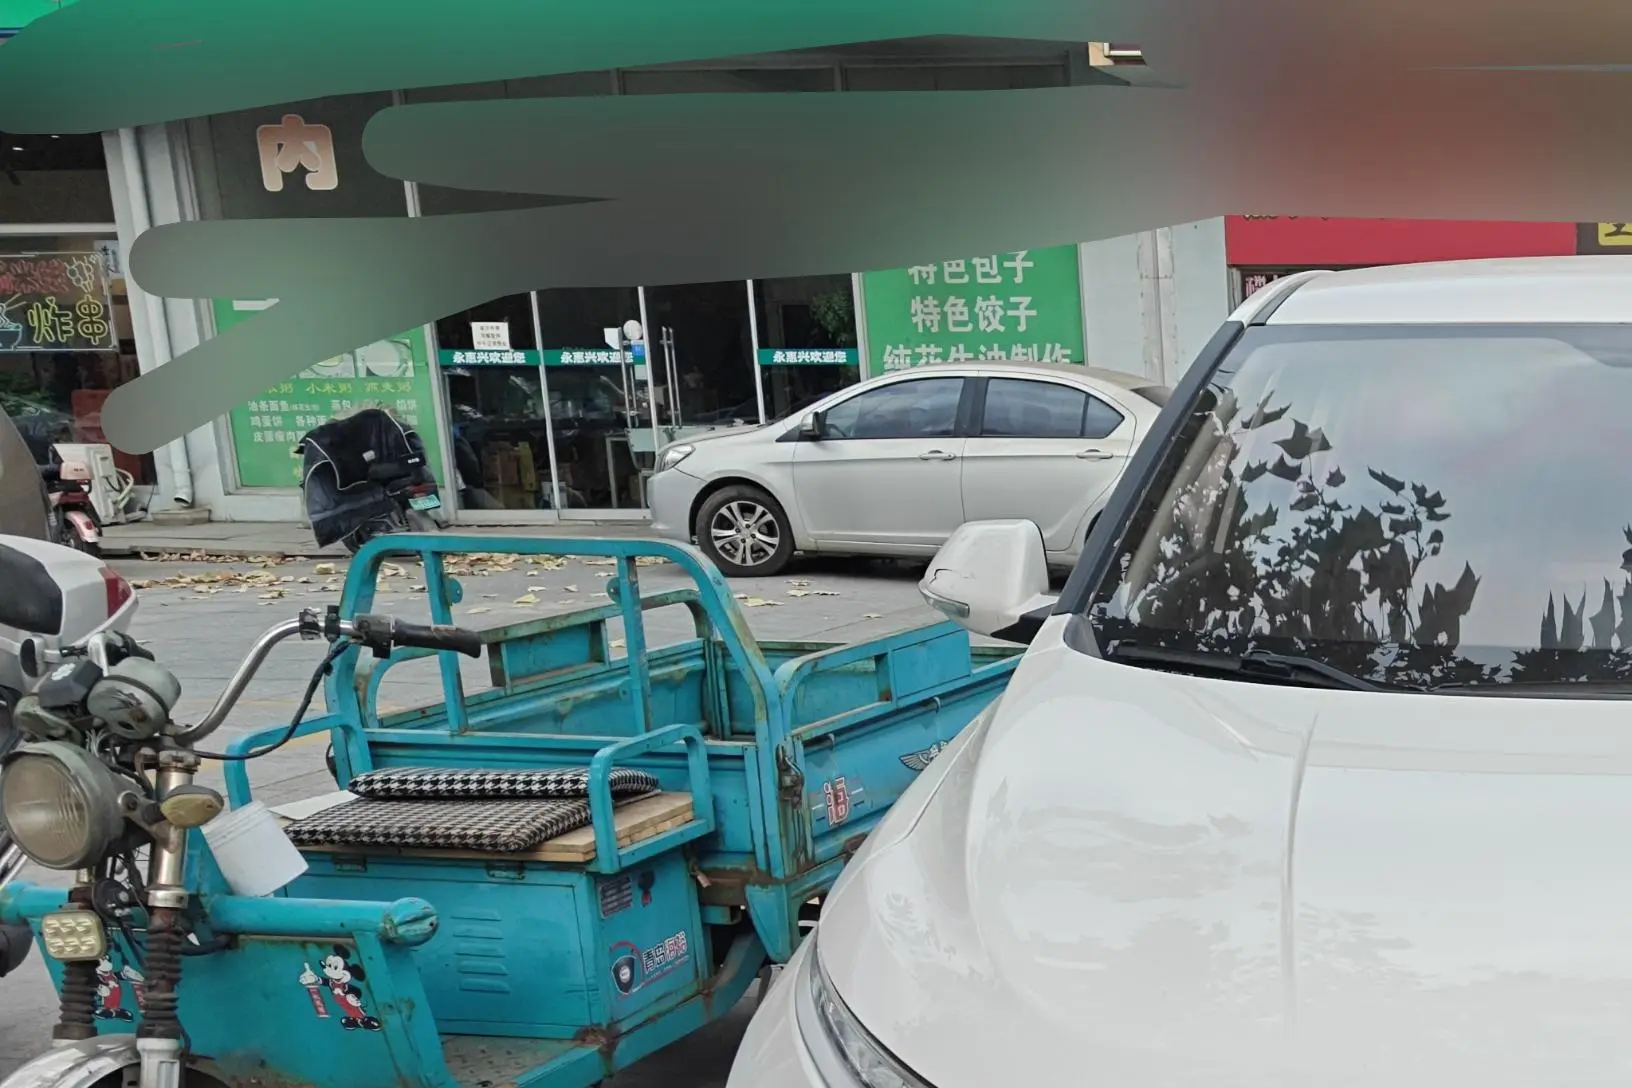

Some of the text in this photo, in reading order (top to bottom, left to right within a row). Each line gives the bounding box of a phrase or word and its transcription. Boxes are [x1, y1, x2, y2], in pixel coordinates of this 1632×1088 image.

[27, 294, 109, 346] 炸串
[911, 295, 1038, 333] 特色饺子
[453, 351, 526, 364] 永惠兴欢迎您
[560, 351, 634, 364] 永惠兴欢迎您
[773, 350, 847, 363] 永惠兴欢迎您
[305, 383, 352, 394] 小米粥
